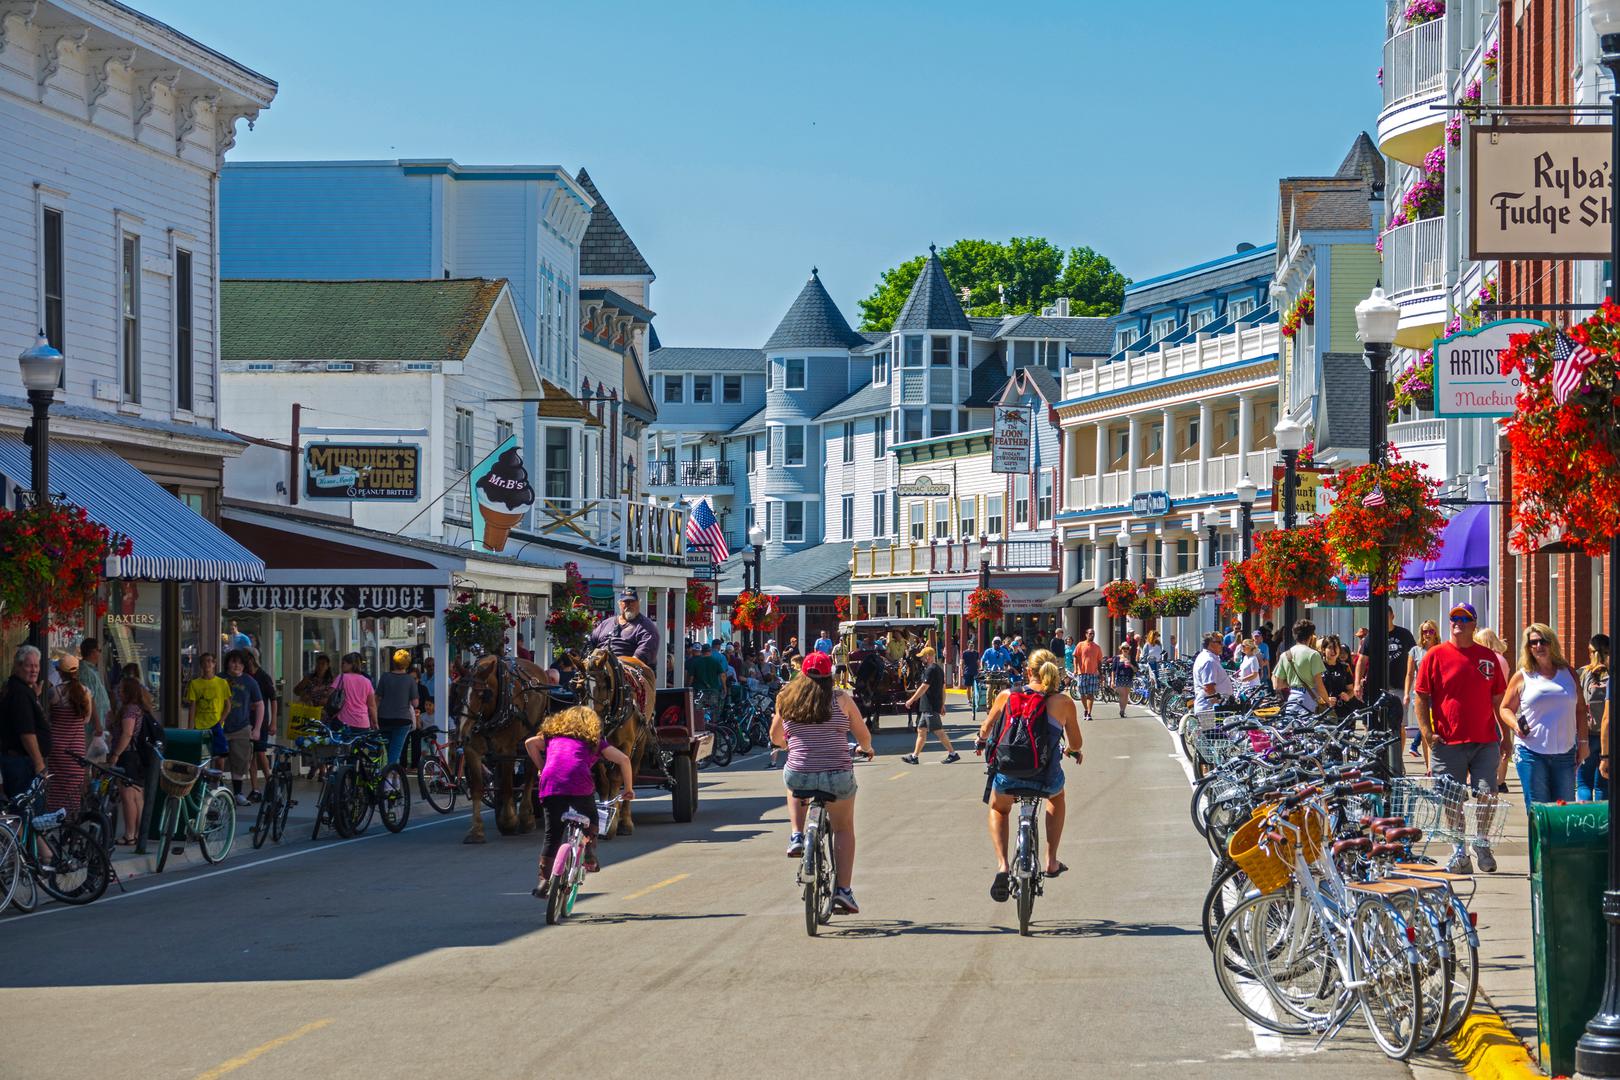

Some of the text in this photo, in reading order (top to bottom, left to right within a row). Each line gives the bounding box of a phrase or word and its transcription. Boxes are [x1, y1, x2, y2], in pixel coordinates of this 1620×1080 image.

[1490, 192, 1612, 234] Fudge Sh
[1450, 349, 1502, 375] ARTIST
[1455, 391, 1517, 407] Mackin
[995, 438, 1029, 446] FEATHER
[1001, 430, 1023, 438] LOON
[310, 447, 415, 476] MURDICK'S
[357, 469, 414, 489] FUDGE
[358, 489, 384, 497] PEANUT
[387, 489, 414, 497] BRITTLE
[686, 555, 707, 563] ORRAL
[238, 587, 424, 608] MURDICKS FUDGE
[107, 614, 155, 624] BAXTERS
